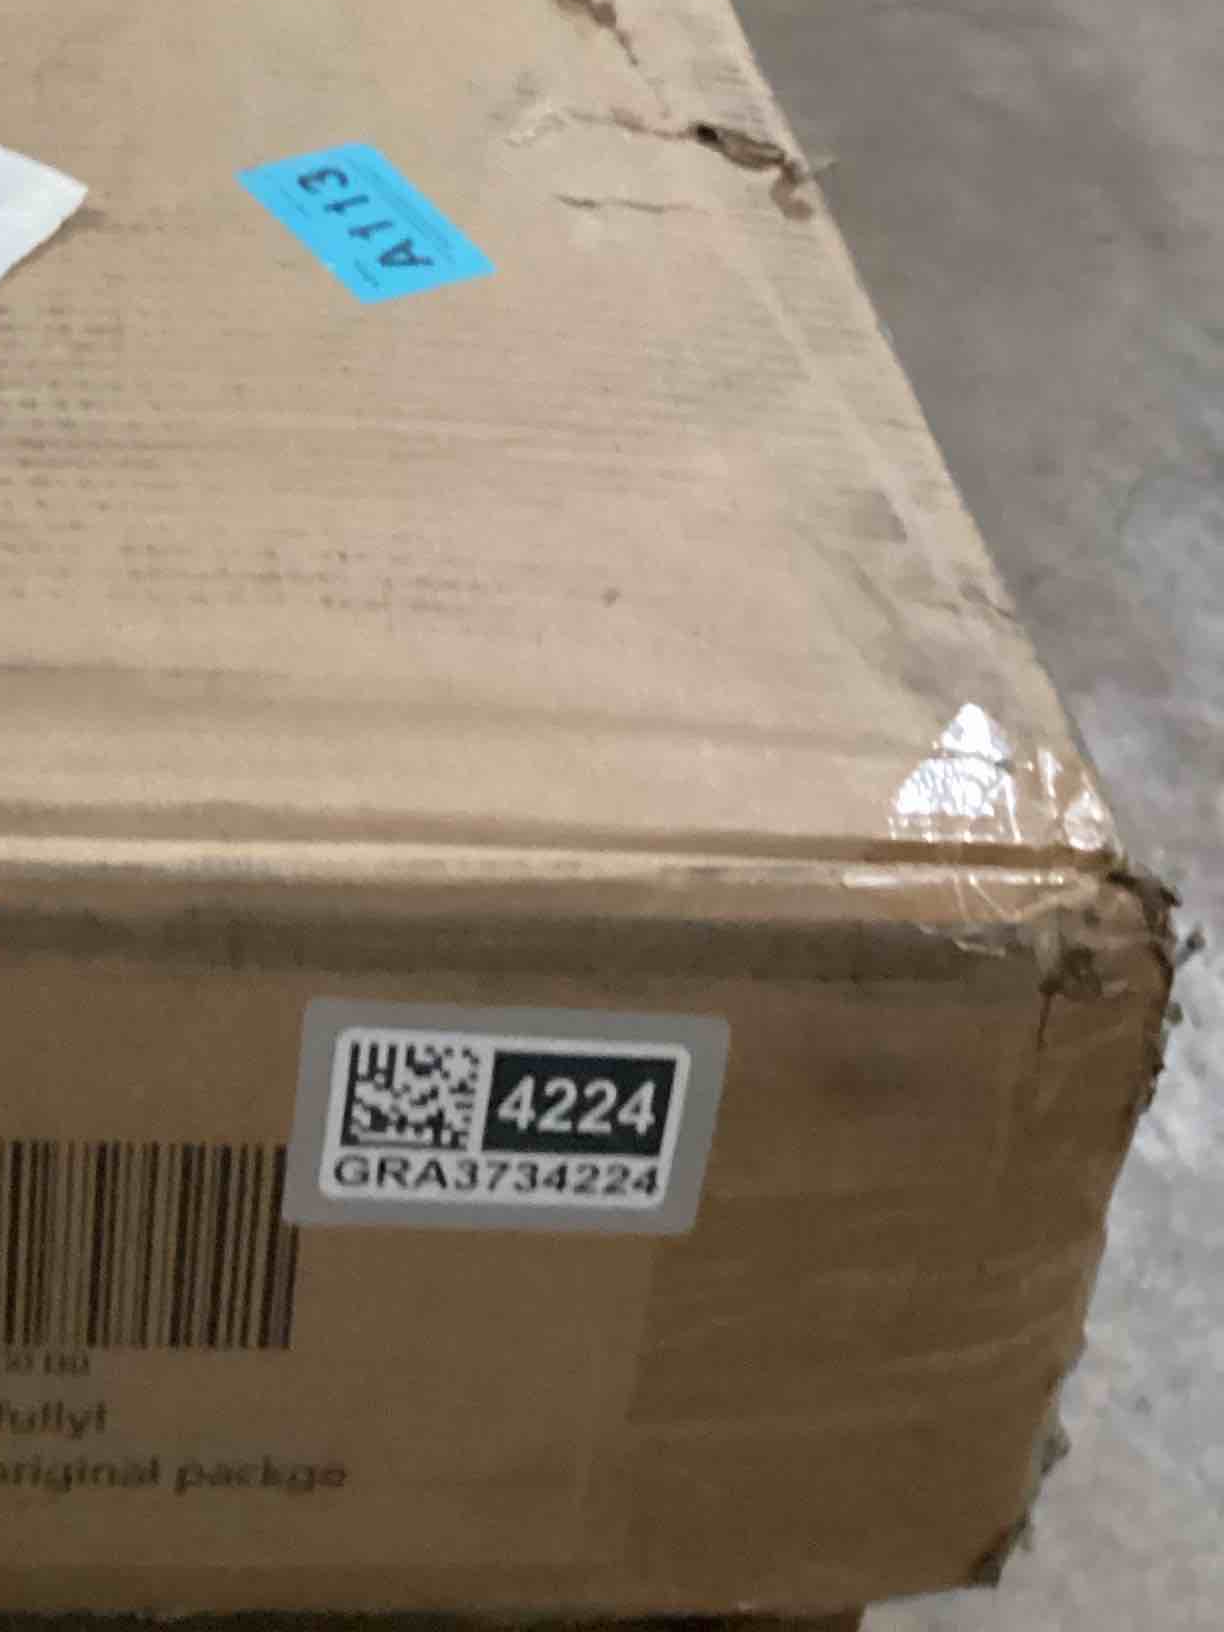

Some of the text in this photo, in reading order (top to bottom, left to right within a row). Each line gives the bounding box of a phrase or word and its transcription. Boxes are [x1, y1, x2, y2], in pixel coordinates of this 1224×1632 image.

[297, 167, 435, 268] A113
[498, 1075, 657, 1135] 4224
[334, 1154, 658, 1197] GRA3734224
